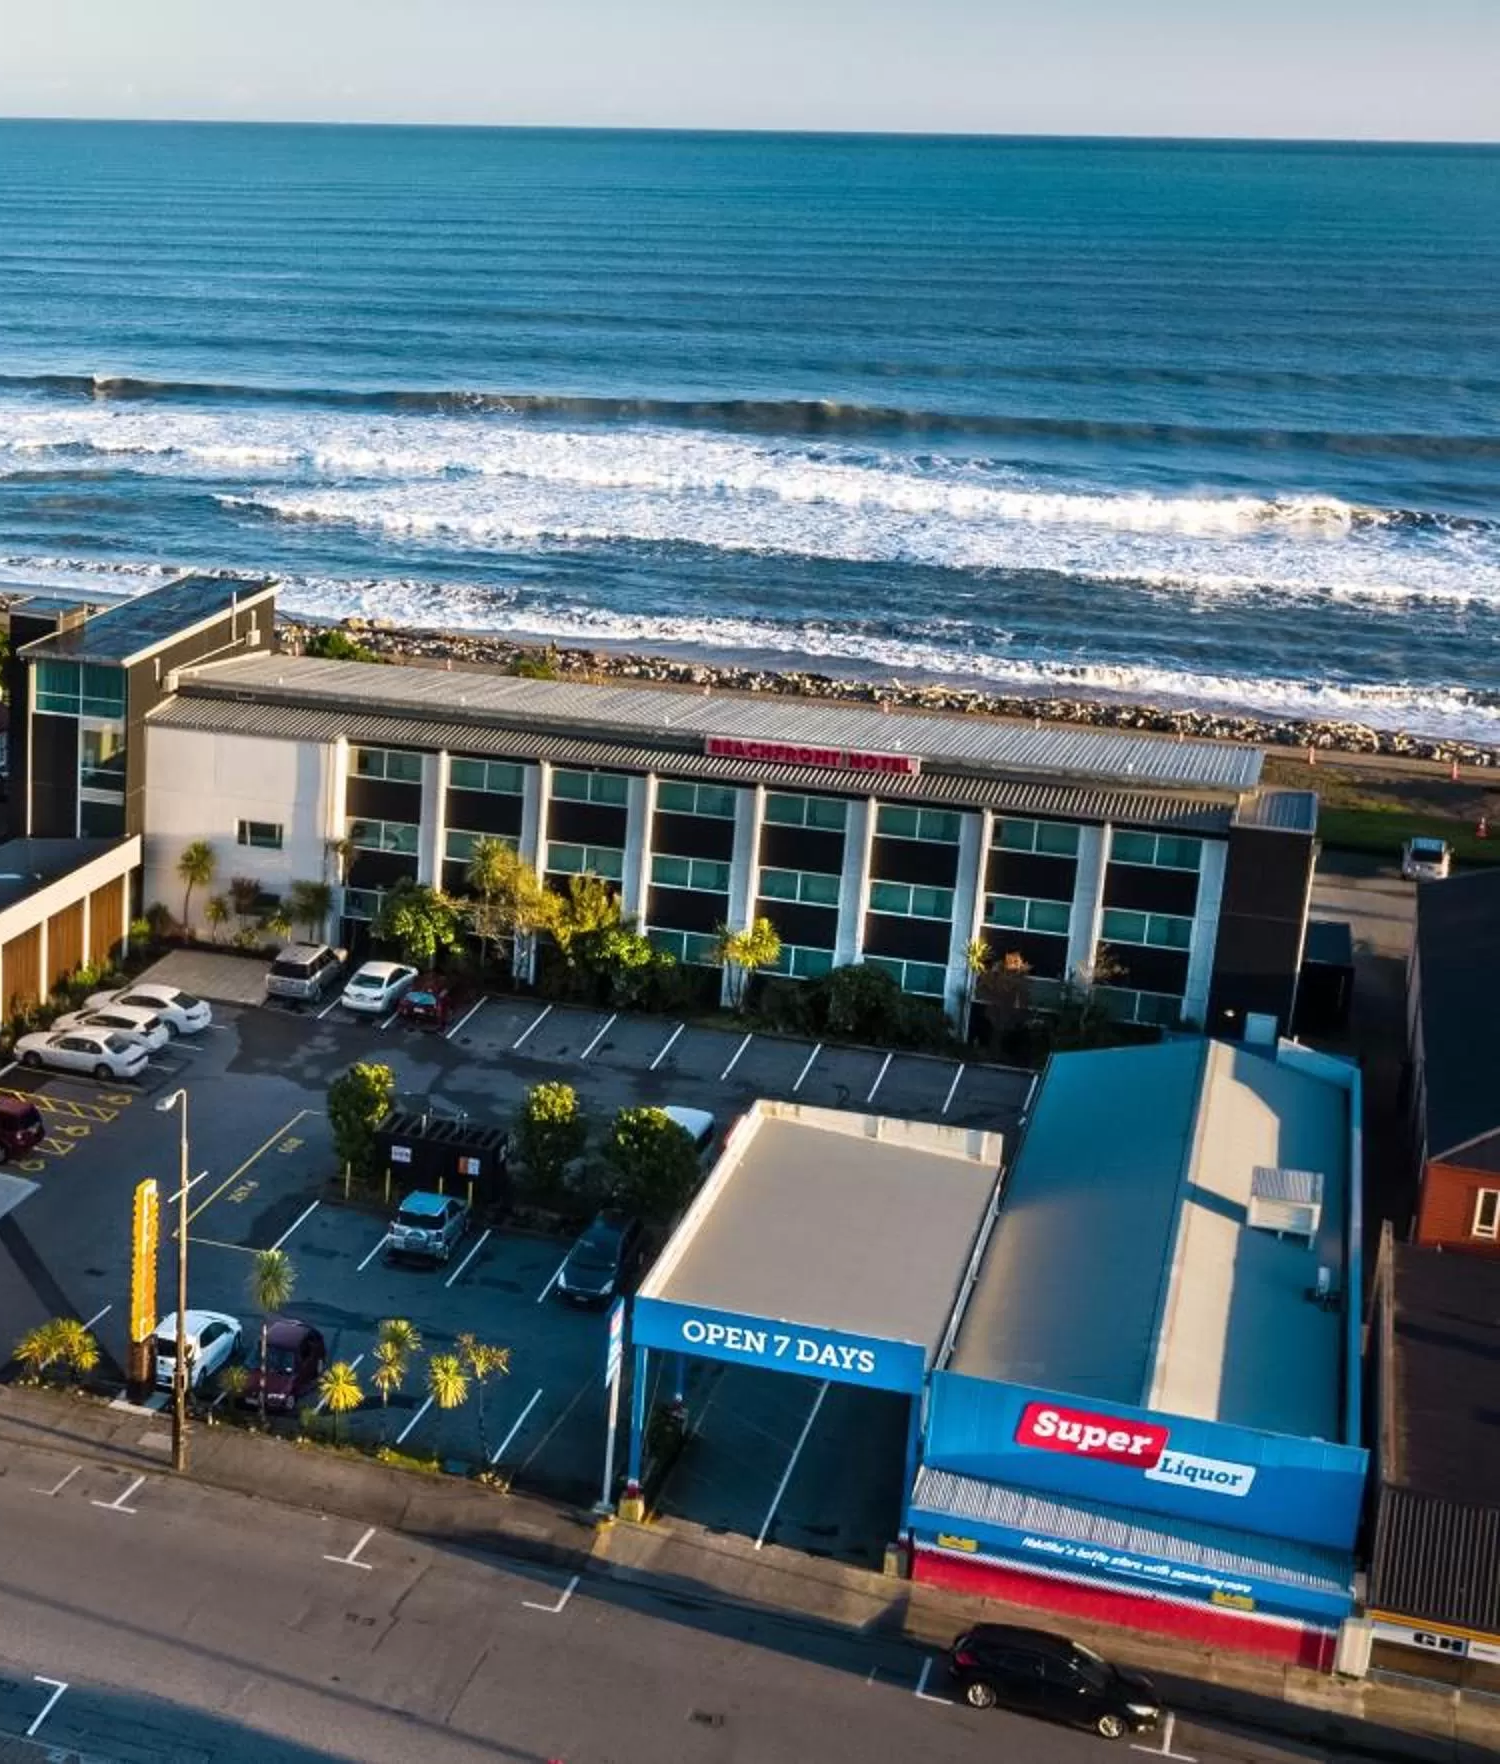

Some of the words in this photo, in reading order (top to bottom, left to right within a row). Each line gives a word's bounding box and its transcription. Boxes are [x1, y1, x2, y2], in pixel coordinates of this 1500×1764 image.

[710, 740, 840, 767] BEACHFRONT
[849, 753, 913, 774] HOTEL
[682, 1320, 767, 1354] OPEN
[773, 1335, 791, 1357] 7
[796, 1339, 875, 1373] DAYS
[1032, 1410, 1153, 1456] Super
[1160, 1457, 1243, 1487] Liquor
